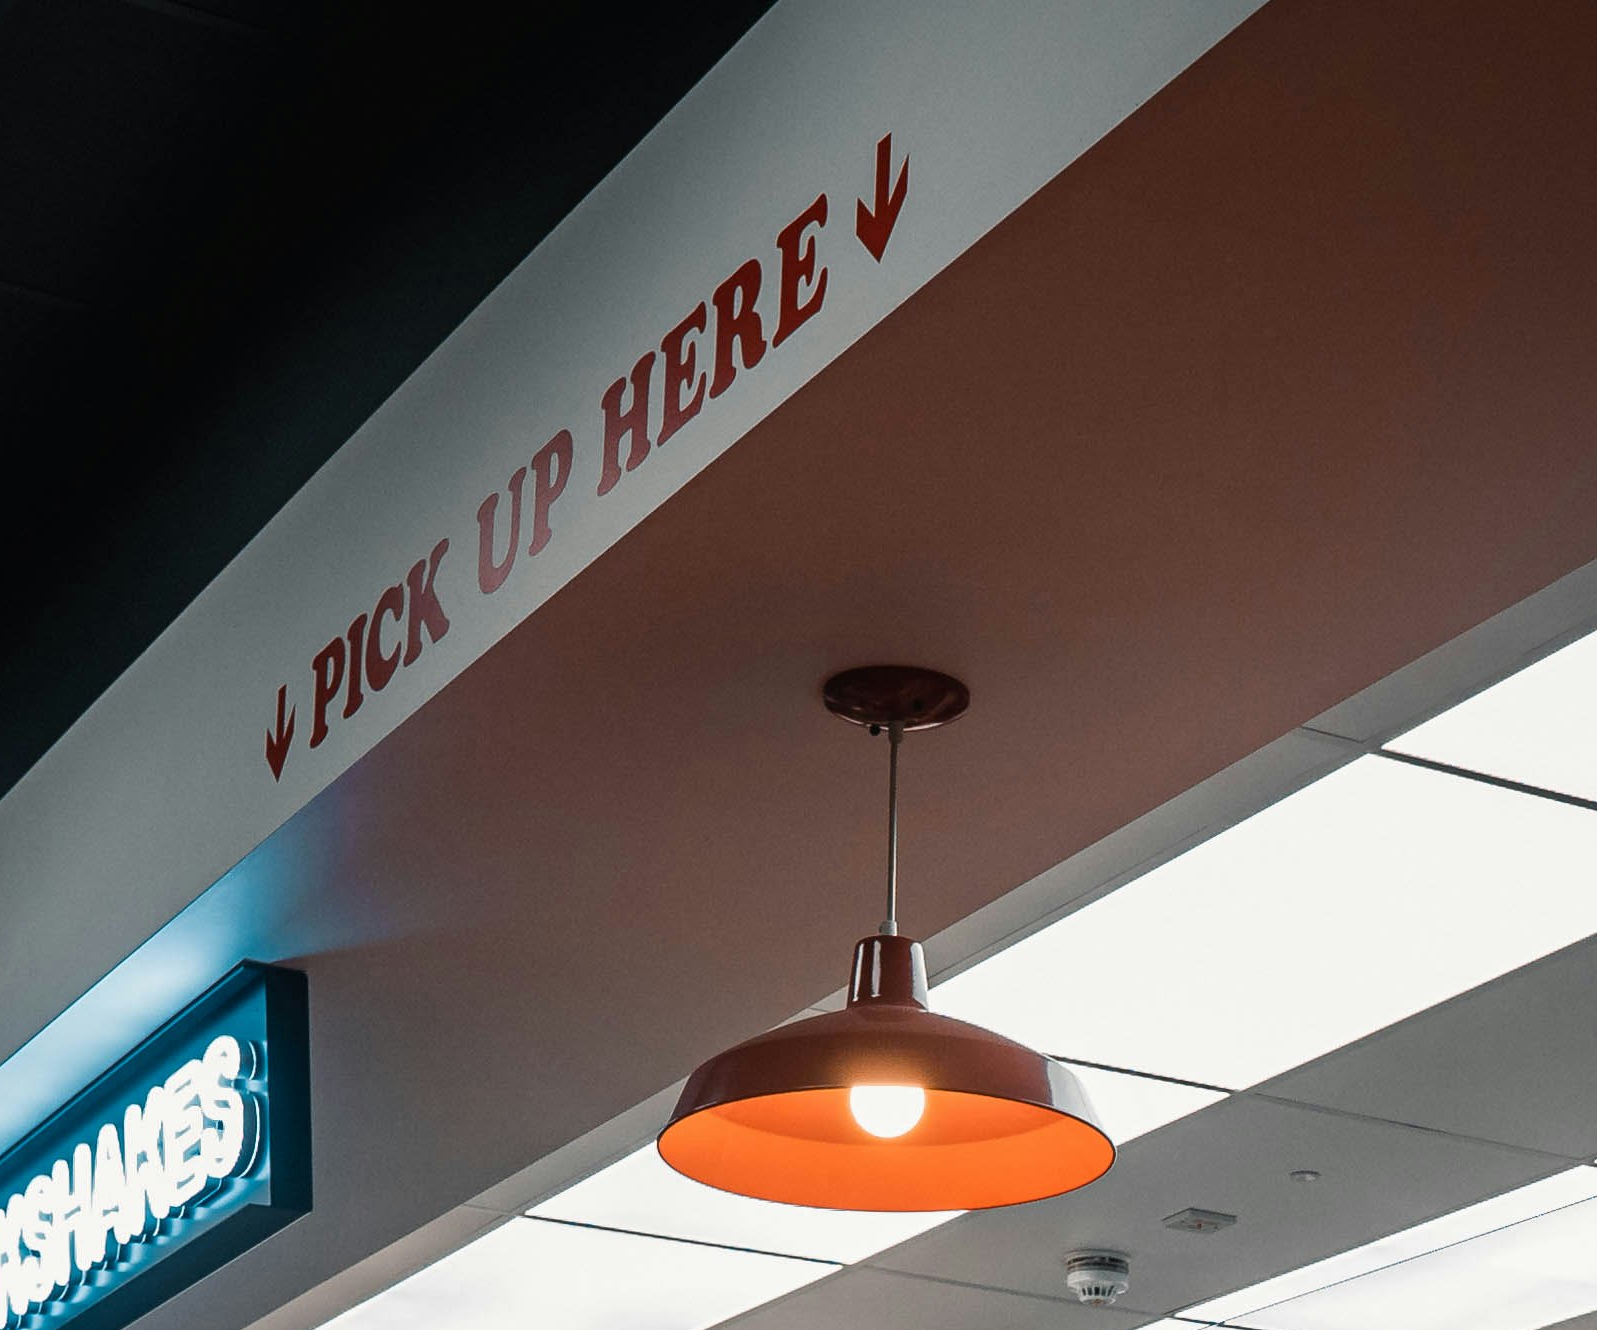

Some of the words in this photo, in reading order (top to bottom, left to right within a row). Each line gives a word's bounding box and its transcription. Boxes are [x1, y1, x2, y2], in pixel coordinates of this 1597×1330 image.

[309, 538, 449, 749] PICK
[476, 429, 574, 595] UP
[596, 192, 829, 497] HERE
